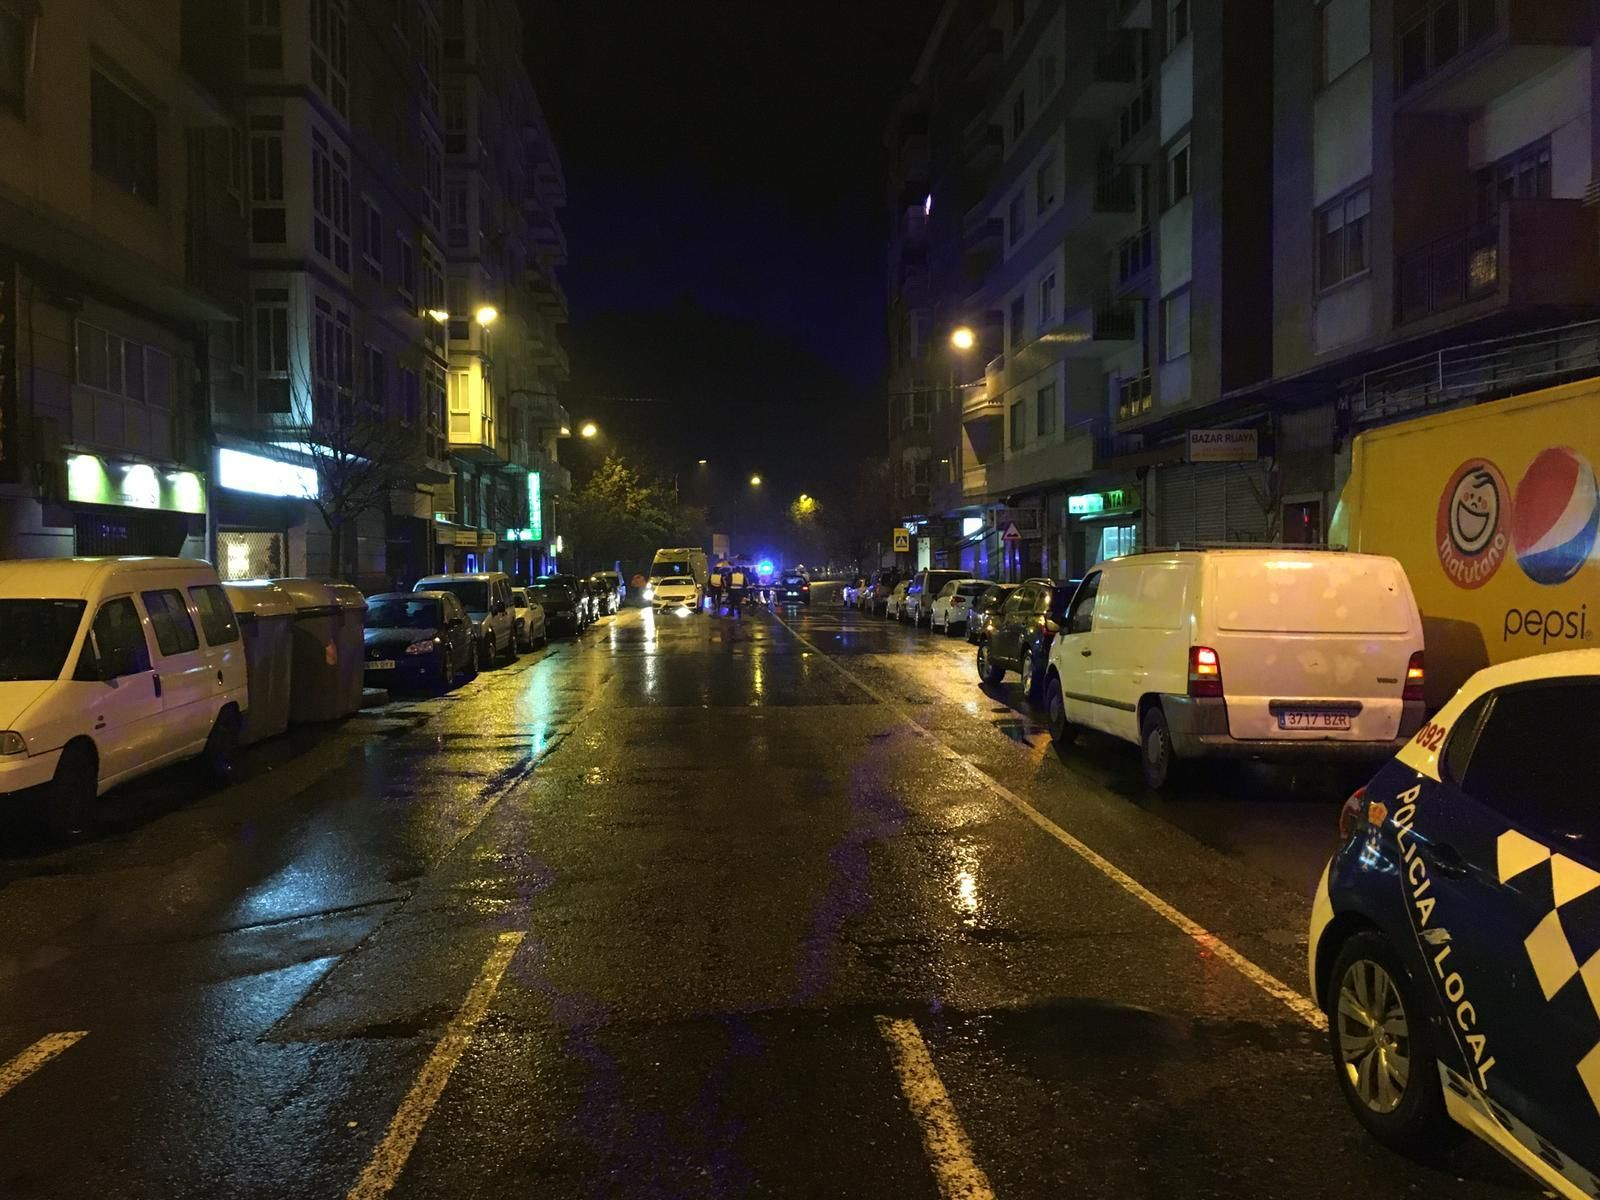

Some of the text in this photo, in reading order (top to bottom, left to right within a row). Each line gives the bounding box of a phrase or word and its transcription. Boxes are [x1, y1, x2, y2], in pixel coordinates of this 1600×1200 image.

[1192, 434, 1223, 443] BAZAR
[1440, 533, 1505, 583] matutano
[1503, 603, 1587, 645] pepsi
[1288, 713, 1347, 726] 3717 BZR
[1415, 721, 1446, 752] 092
[1393, 784, 1496, 1091] POLICIA LOCAL
